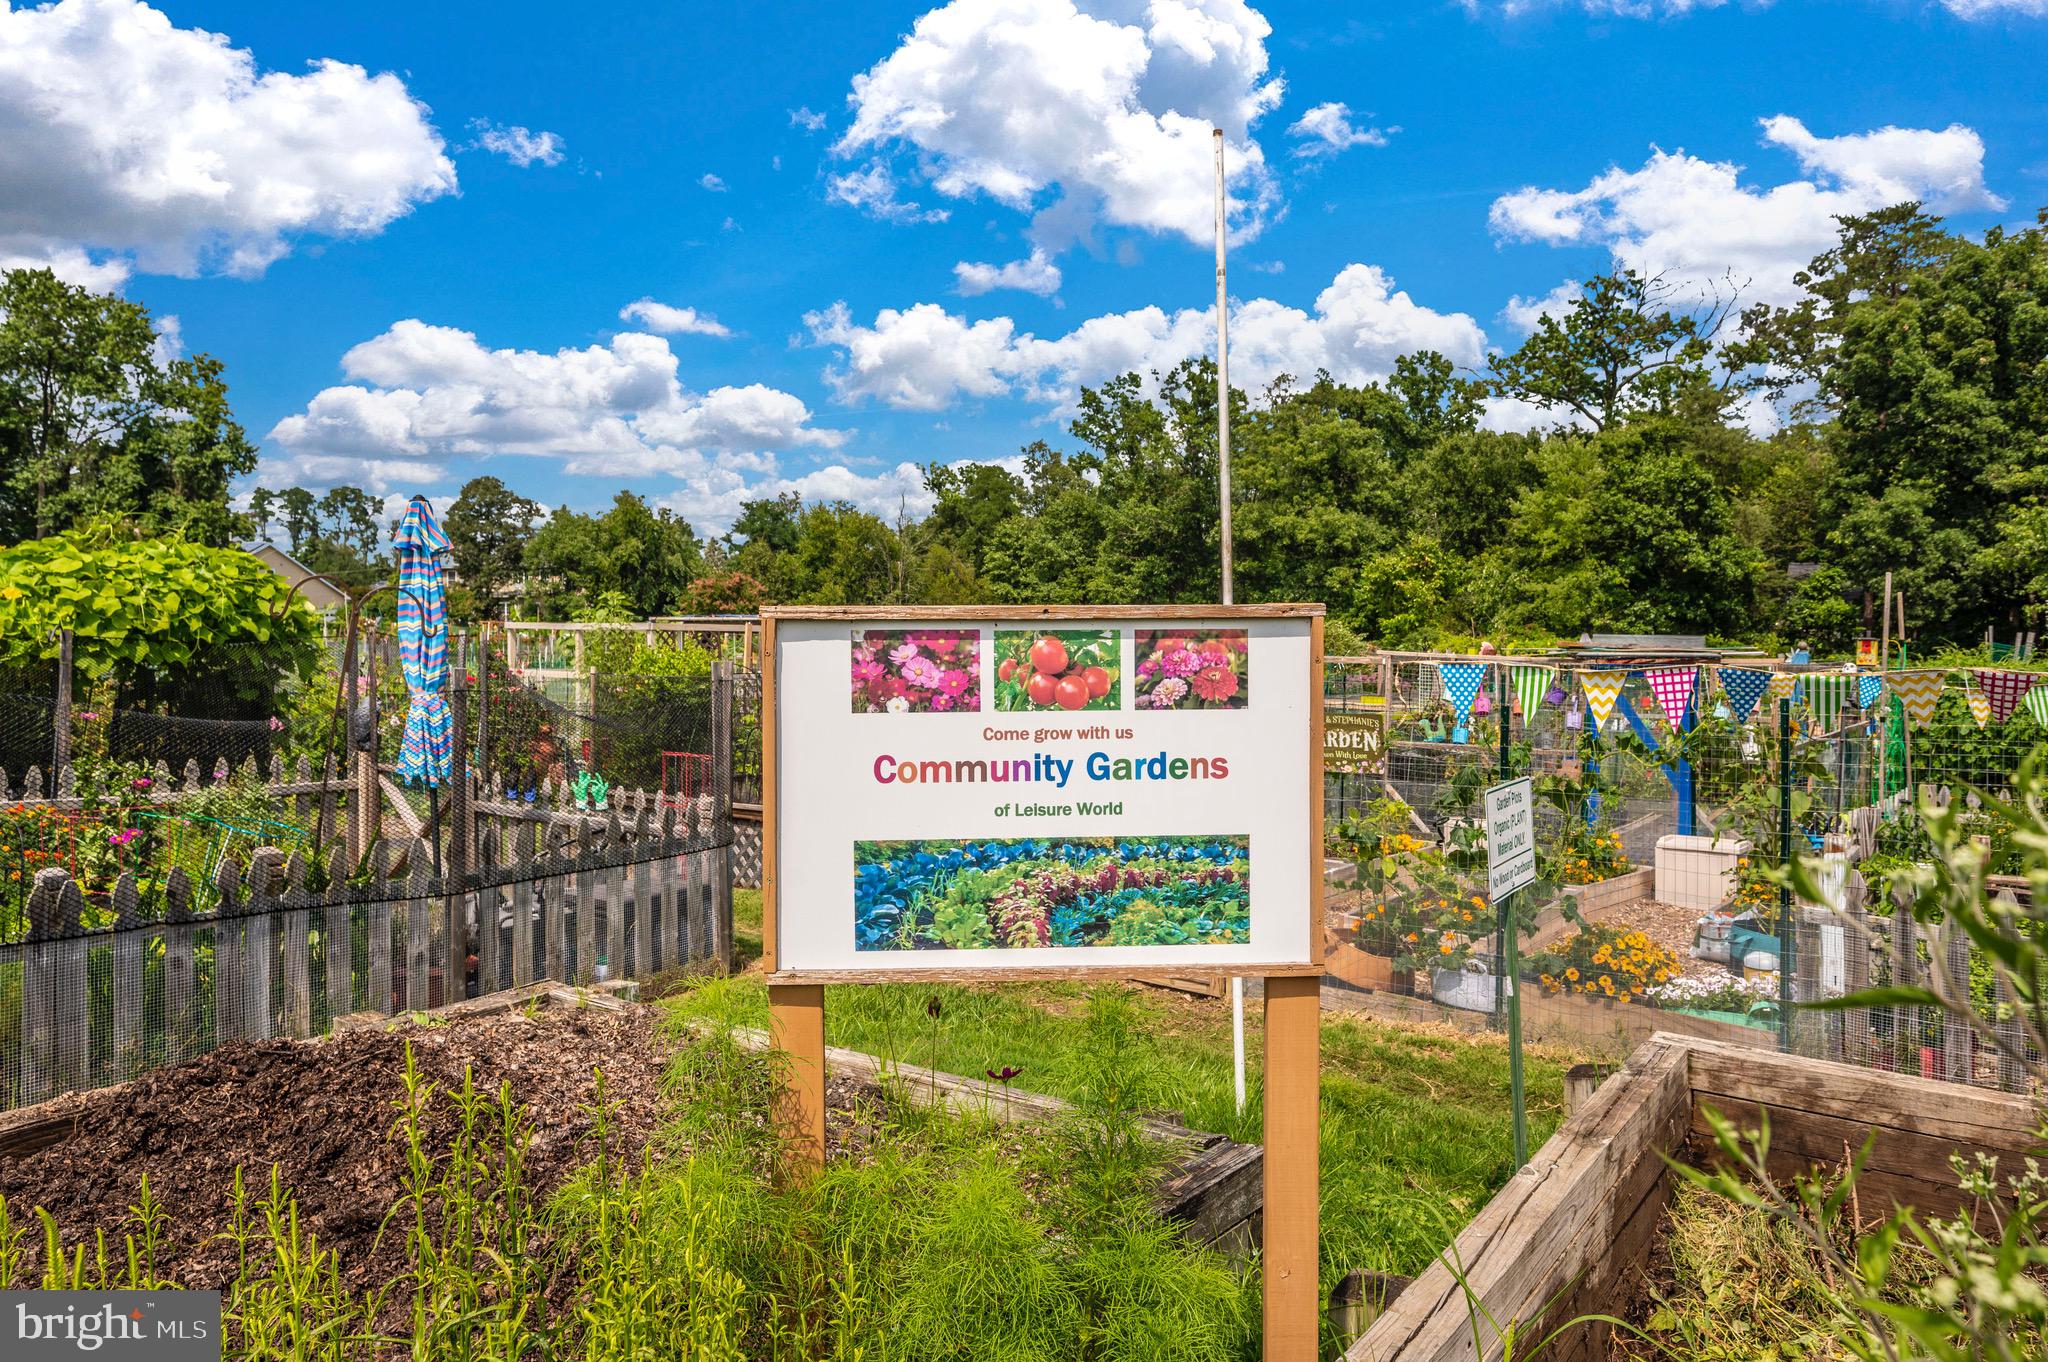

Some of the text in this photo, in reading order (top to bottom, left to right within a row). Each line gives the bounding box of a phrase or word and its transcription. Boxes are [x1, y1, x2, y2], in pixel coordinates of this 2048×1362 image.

[982, 725, 1134, 744] Come grow with us
[1324, 730, 1377, 751] RDEN
[1335, 750, 1352, 759] With
[1352, 751, 1368, 760] Love
[873, 751, 1229, 789] Community Gardens
[994, 801, 1123, 817] of Leisure World
[1497, 791, 1522, 811] Garden Plots
[1494, 810, 1527, 837] Organic (PLANT)
[1497, 837, 1513, 857] Material
[1493, 876, 1499, 889] No
[1514, 858, 1533, 877] Cardboard
